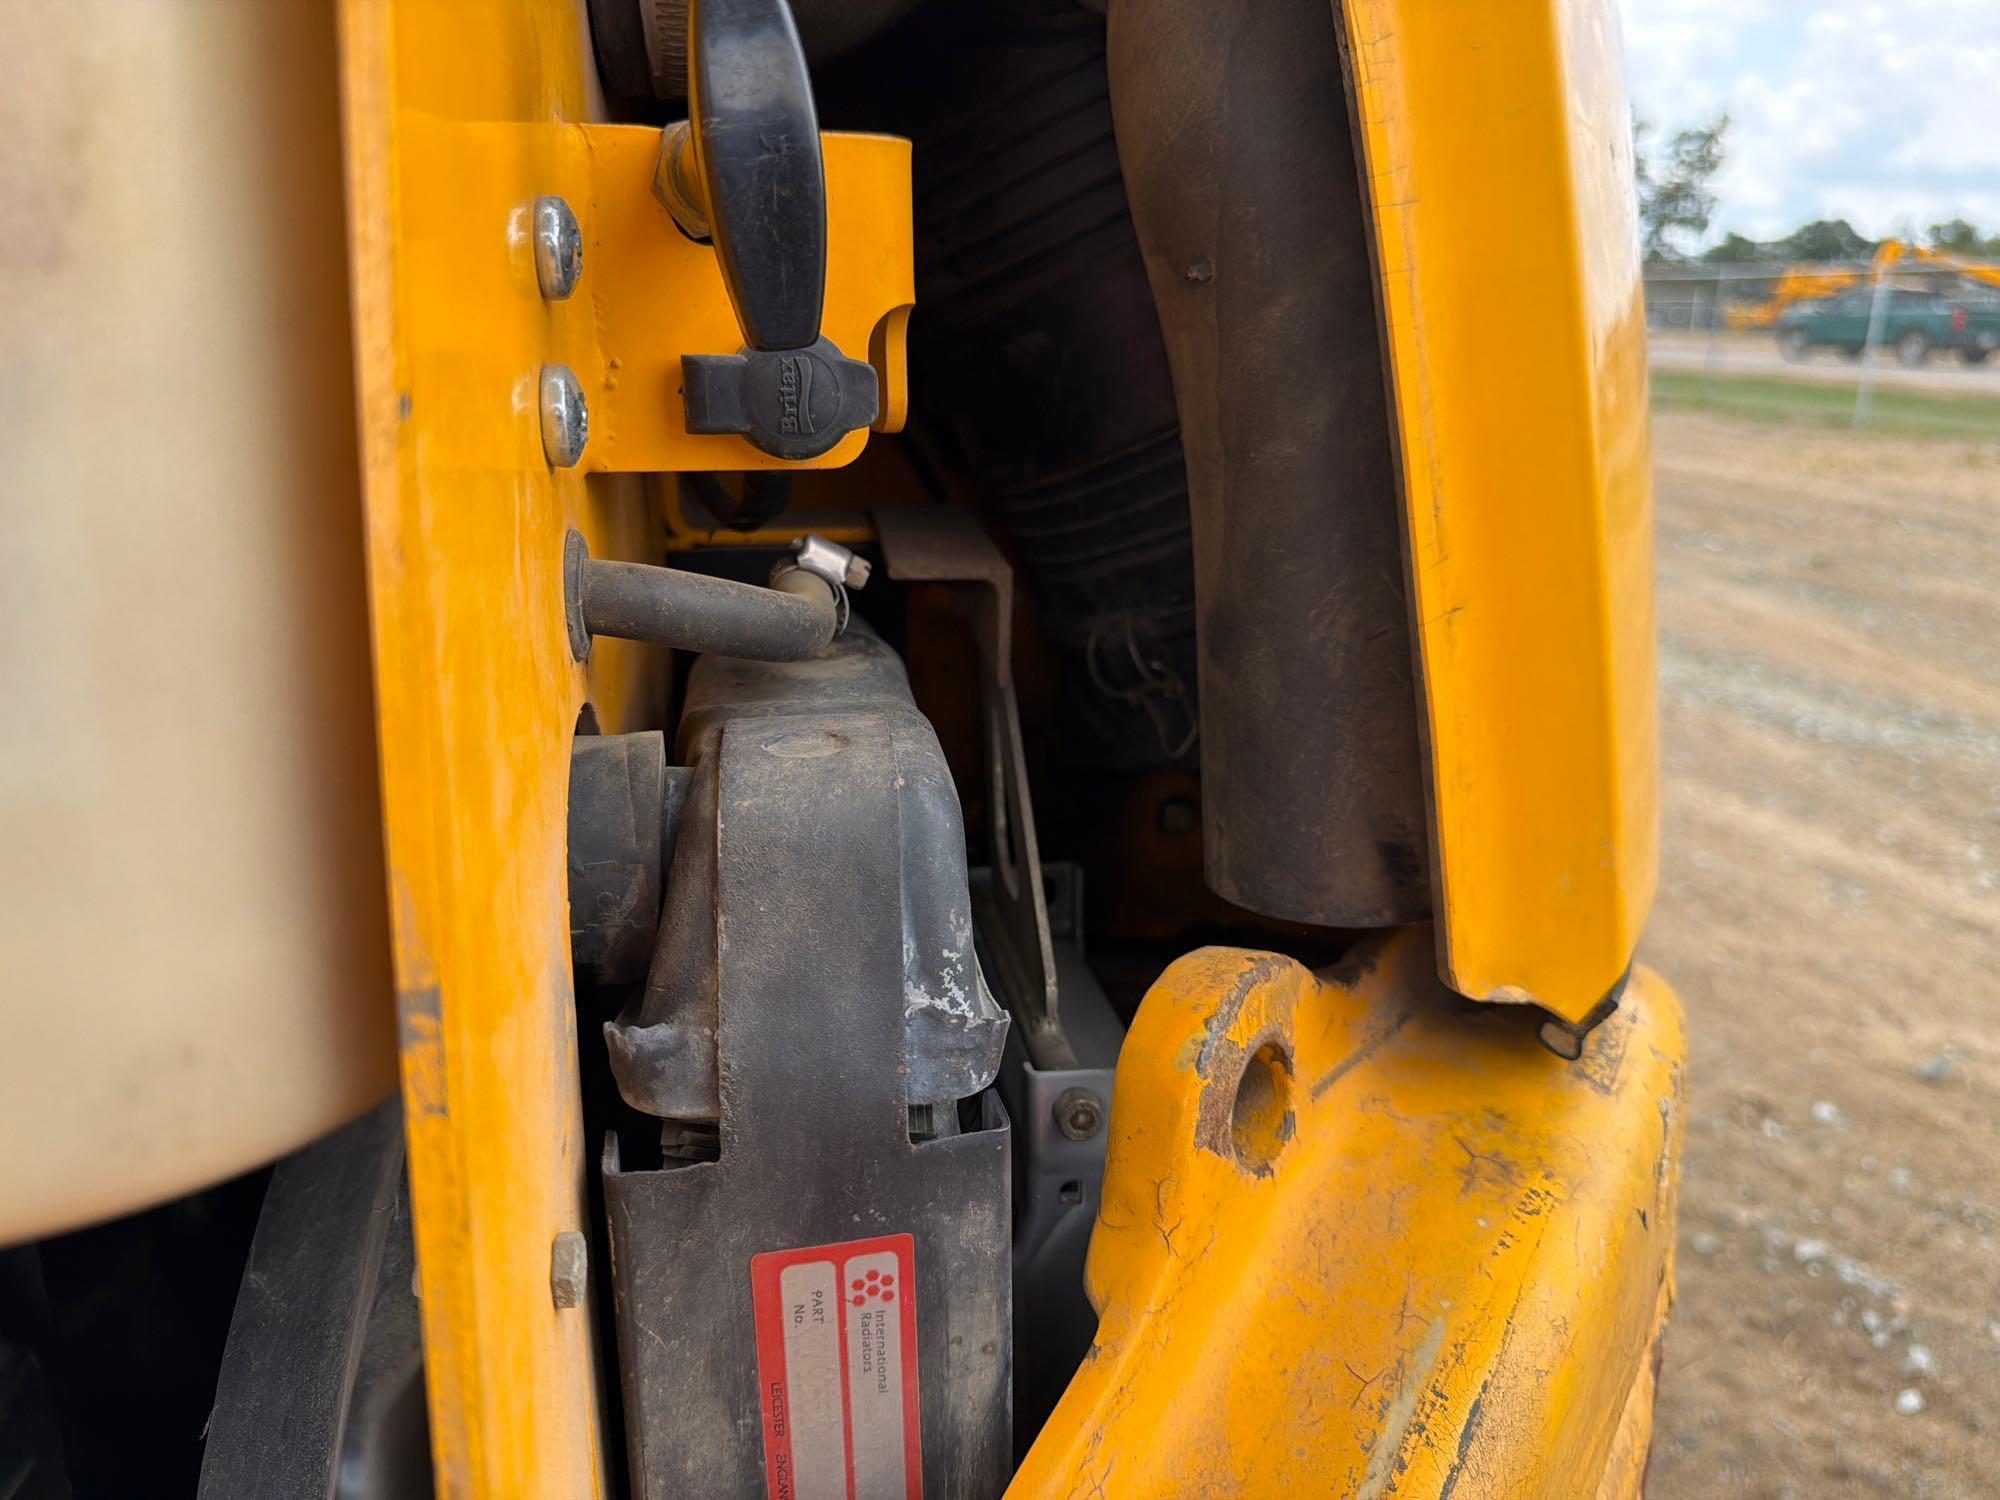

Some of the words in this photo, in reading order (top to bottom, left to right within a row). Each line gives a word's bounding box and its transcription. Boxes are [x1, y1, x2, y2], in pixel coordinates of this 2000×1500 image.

[779, 356, 798, 433] Britax
[794, 1304, 804, 1328] No.
[811, 1290, 824, 1324] PART
[861, 1312, 873, 1374] Radiators
[875, 1310, 889, 1394] International
[770, 1382, 785, 1437] LEICESTER
[776, 1454, 789, 1500] ENGLAN
